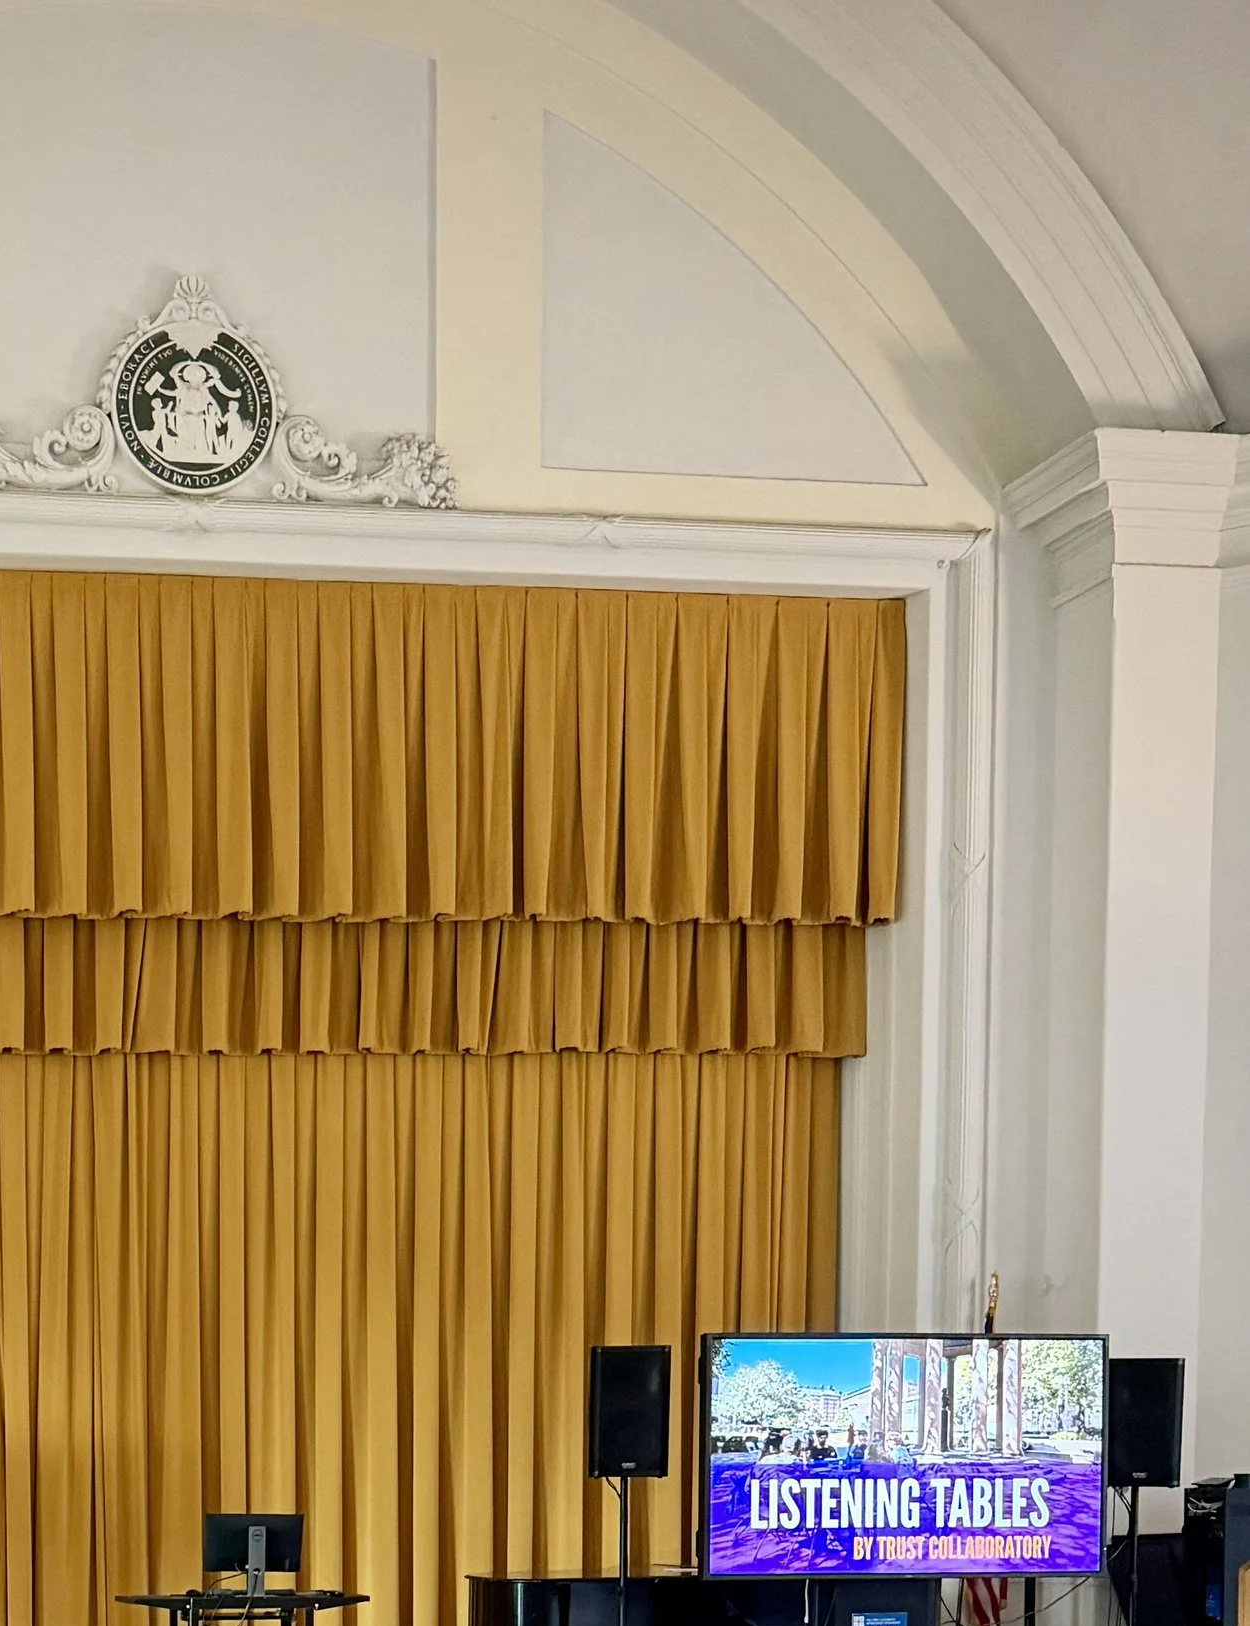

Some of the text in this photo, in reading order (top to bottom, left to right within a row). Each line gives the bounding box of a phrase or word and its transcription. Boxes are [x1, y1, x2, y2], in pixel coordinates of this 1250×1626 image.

[118, 339, 155, 400] EBORACI
[119, 413, 141, 452] NOVI
[230, 417, 271, 477] COLLEGII
[750, 1477, 1051, 1531] LISTENING TABLES
[853, 1534, 1052, 1560] BY TRUST COLLABORATORY
